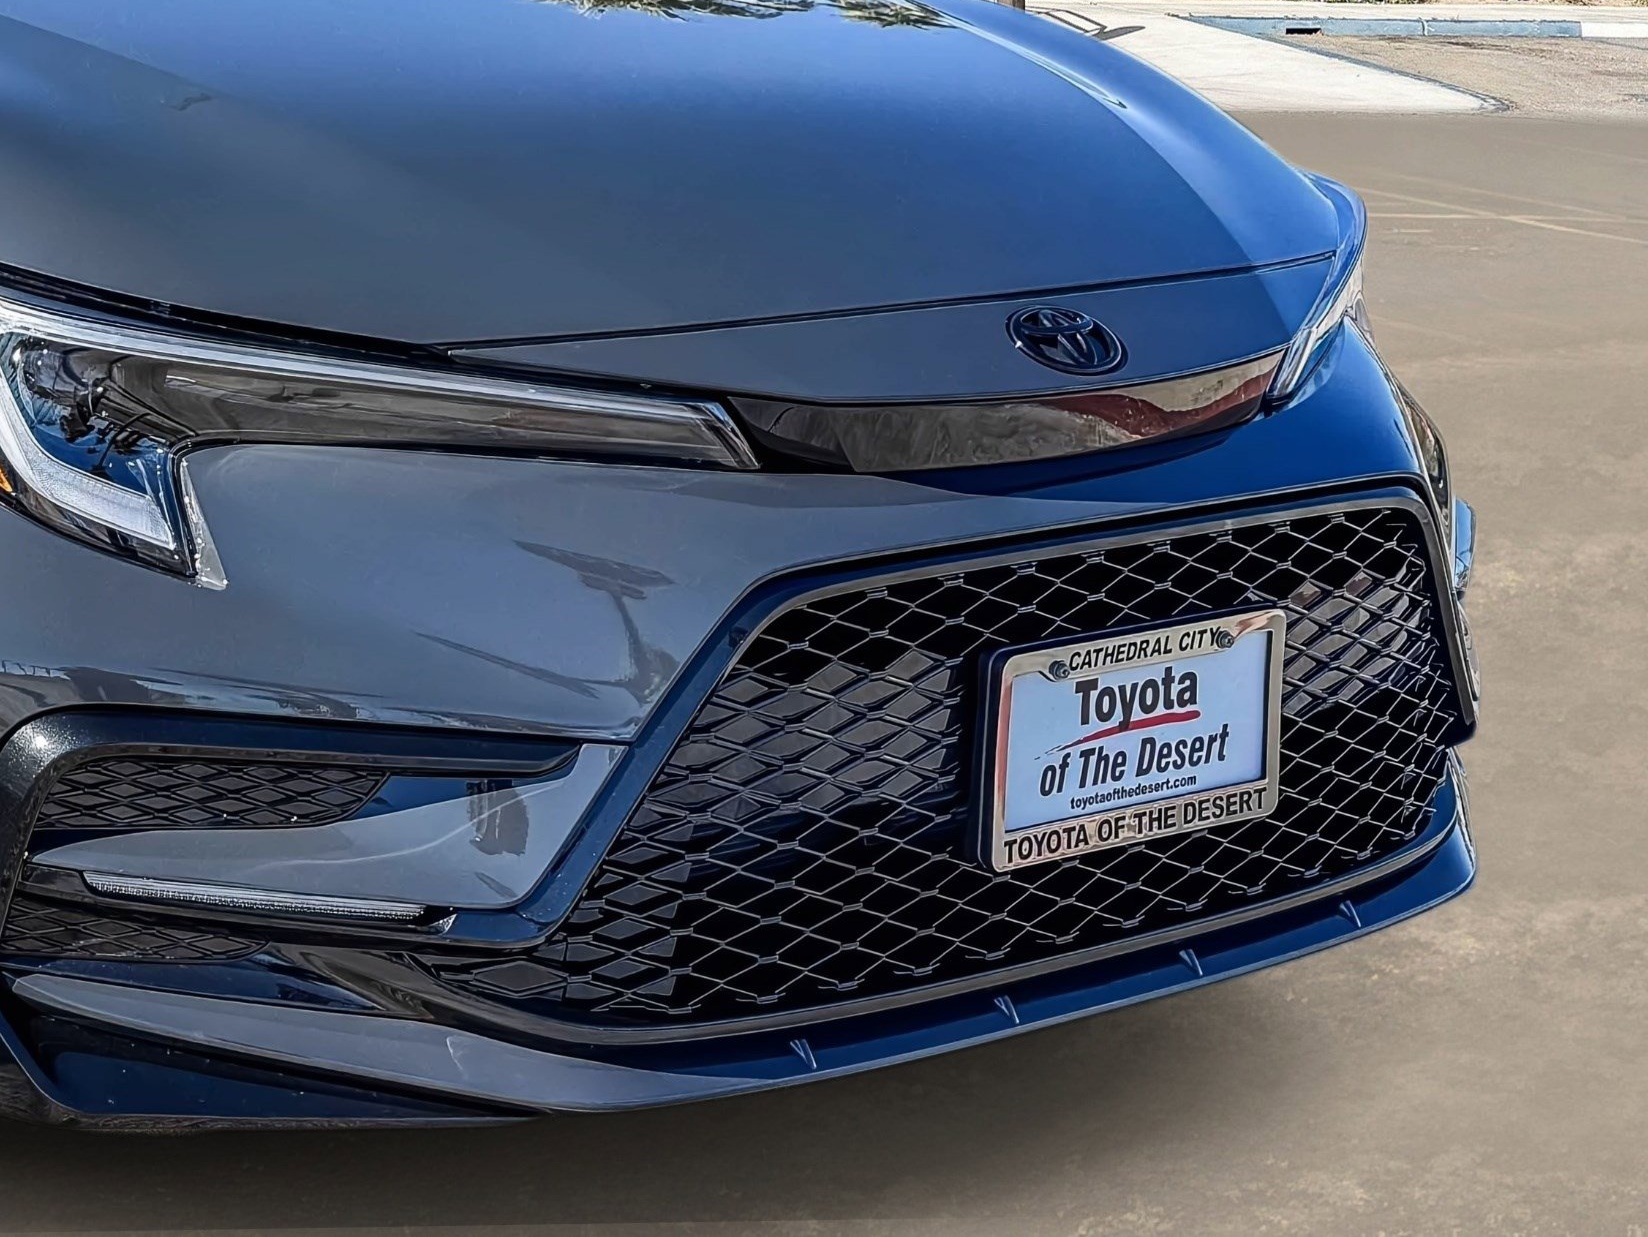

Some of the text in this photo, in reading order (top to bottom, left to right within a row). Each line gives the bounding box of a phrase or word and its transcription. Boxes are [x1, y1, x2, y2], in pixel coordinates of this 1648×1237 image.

[1068, 626, 1220, 671] CATHEDRAL CITY
[1075, 666, 1199, 731] Toyota
[1039, 723, 1230, 797] of The Desert
[1070, 774, 1197, 810] toyotaofthedesert.com
[1004, 787, 1267, 863] TOYOTA OF THE DESERT
